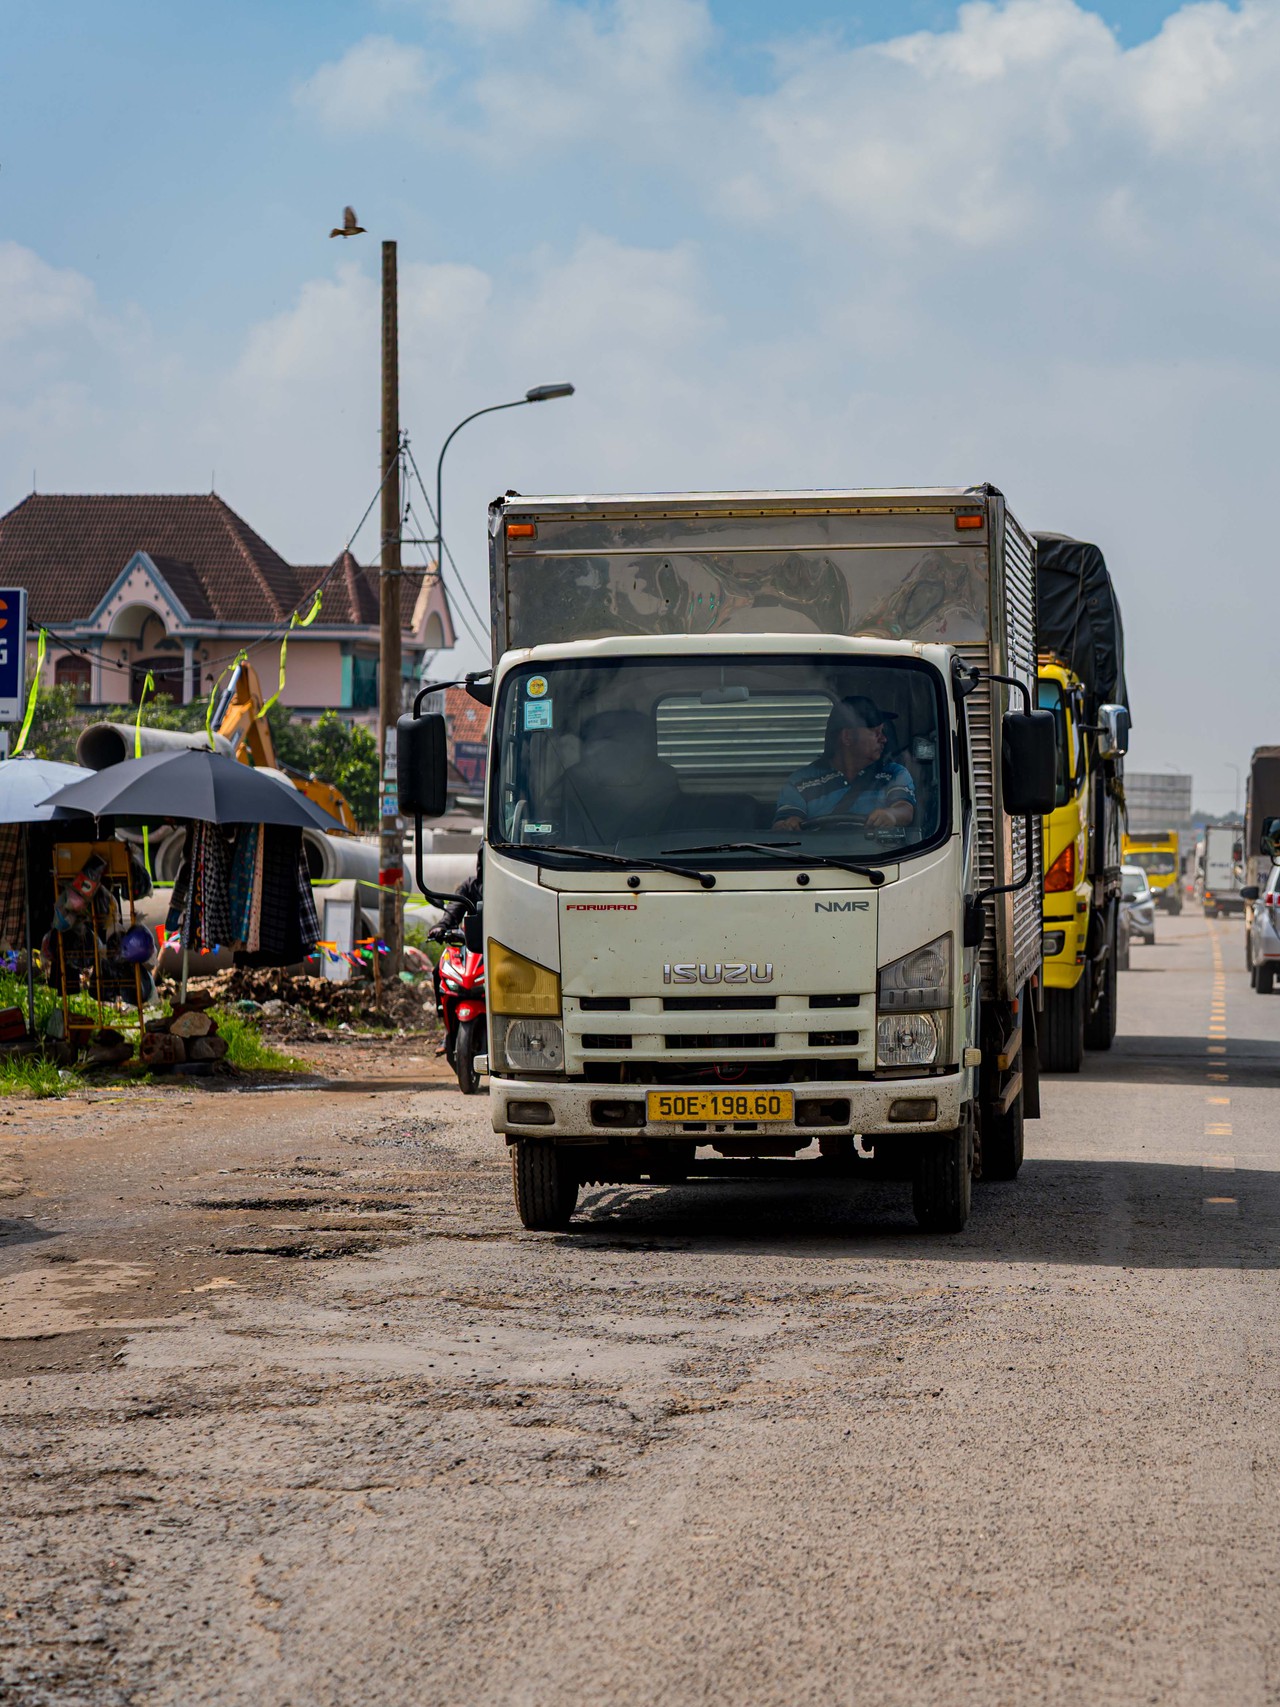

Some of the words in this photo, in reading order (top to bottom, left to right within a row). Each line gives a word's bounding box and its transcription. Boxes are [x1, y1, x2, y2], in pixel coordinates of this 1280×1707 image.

[814, 901, 870, 913] NMR
[663, 963, 774, 984] ISUZU
[660, 1096, 781, 1115] 50E-198.60
